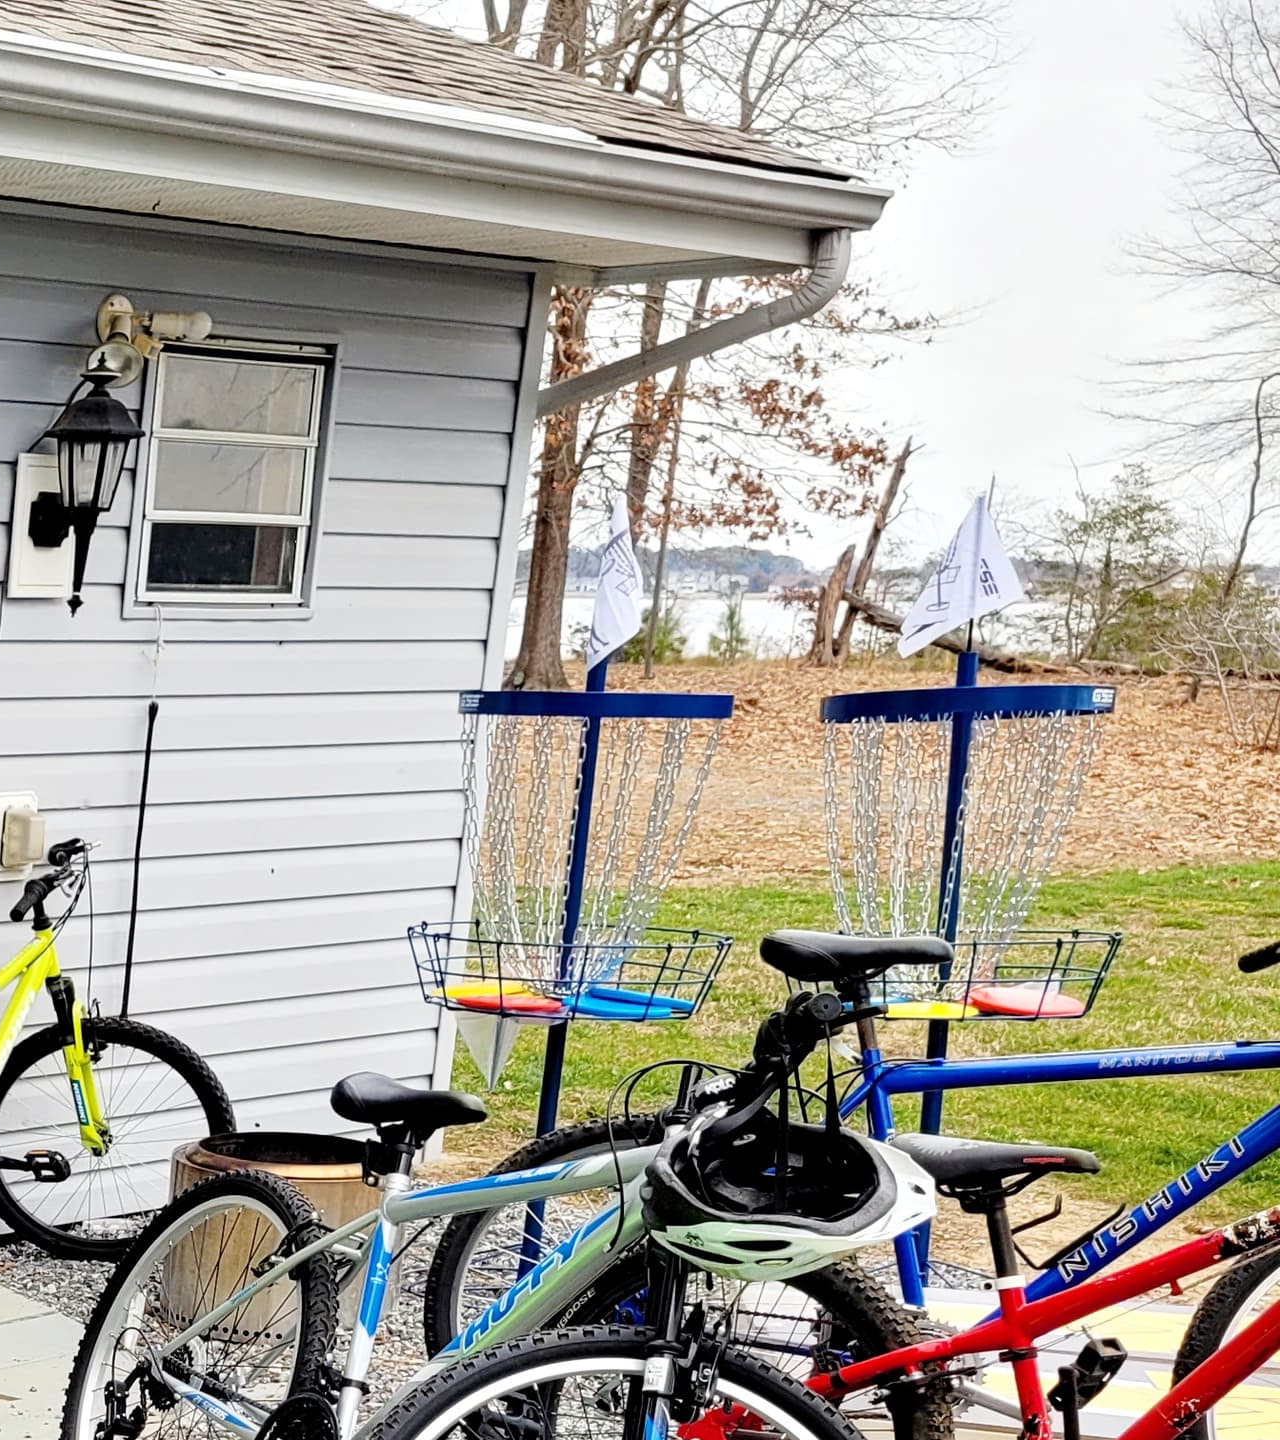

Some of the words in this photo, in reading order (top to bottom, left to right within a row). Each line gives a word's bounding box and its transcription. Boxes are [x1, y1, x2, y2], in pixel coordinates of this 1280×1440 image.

[1098, 1050, 1226, 1069] MANITOBA
[1057, 1137, 1245, 1283] NISHIKI
[461, 1226, 583, 1354] HUFFY
[556, 1287, 597, 1329] GOOSE
